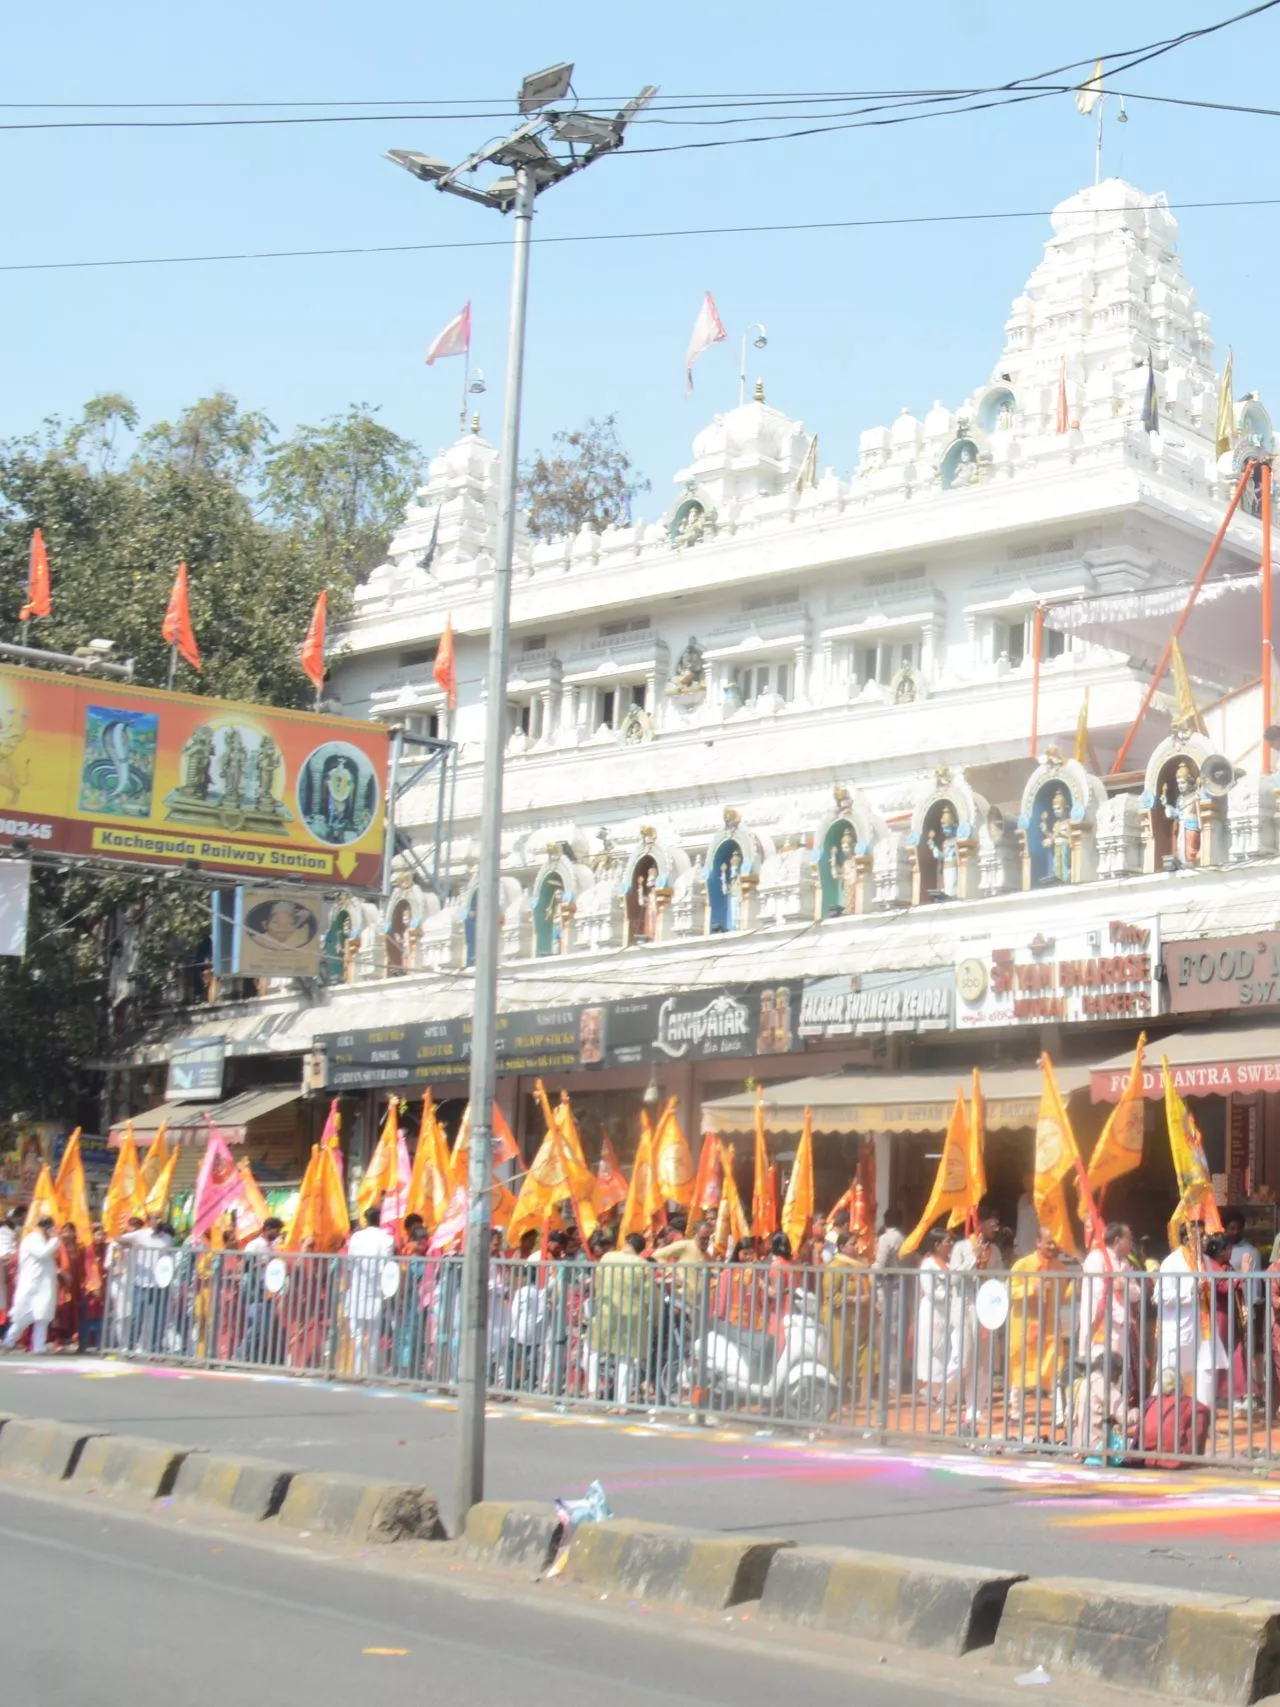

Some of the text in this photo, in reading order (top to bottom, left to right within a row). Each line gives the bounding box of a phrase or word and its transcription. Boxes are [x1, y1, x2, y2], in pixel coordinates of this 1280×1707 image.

[101, 831, 327, 869] Kacheguda Railway Station
[1059, 953, 1152, 990] BHAROSE
[800, 987, 948, 1023] SALASAR SHRINGAR KENDRA
[1110, 1072, 1154, 1092] FOD
